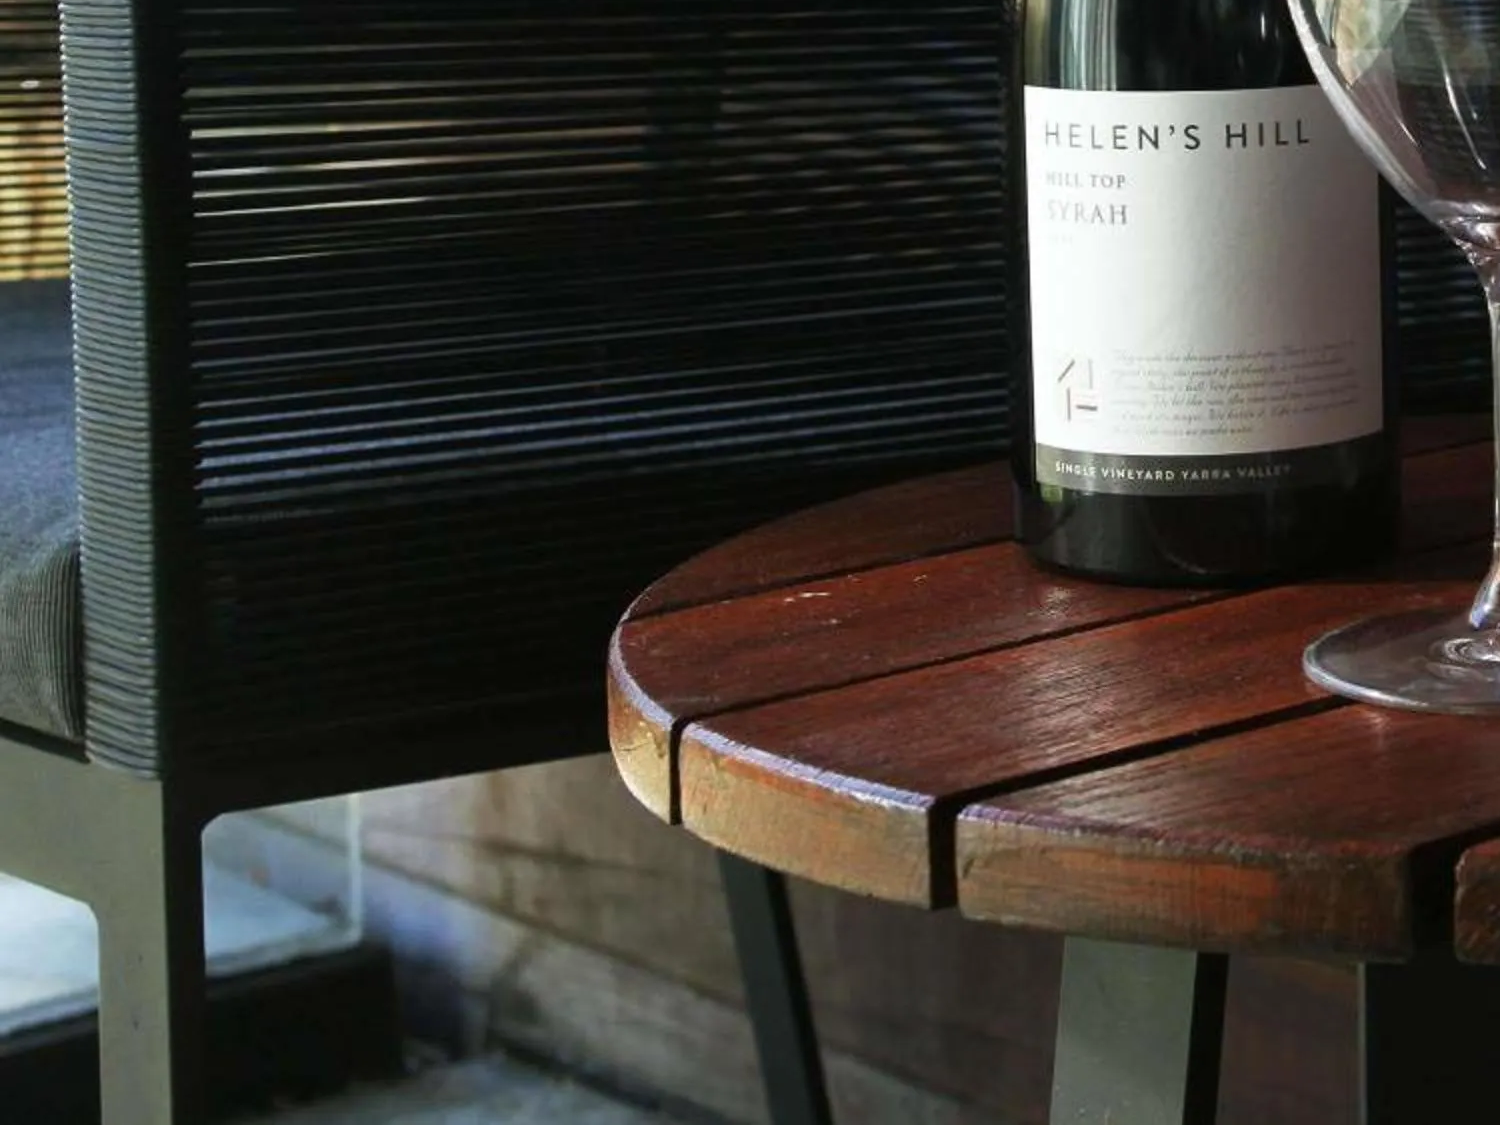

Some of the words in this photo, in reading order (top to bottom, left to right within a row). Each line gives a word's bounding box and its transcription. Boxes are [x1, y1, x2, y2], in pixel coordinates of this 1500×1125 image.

[1044, 120, 1202, 151] HELEN'S
[1225, 118, 1310, 149] HILL
[1046, 171, 1085, 189] HILL
[1090, 173, 1126, 190] TOP
[1047, 198, 1128, 226] SYRAH
[1055, 460, 1097, 478] SINGLE
[1102, 467, 1175, 481] VINEYARD
[1181, 469, 1231, 481] YARRA
[1236, 463, 1292, 478] VALLEY
